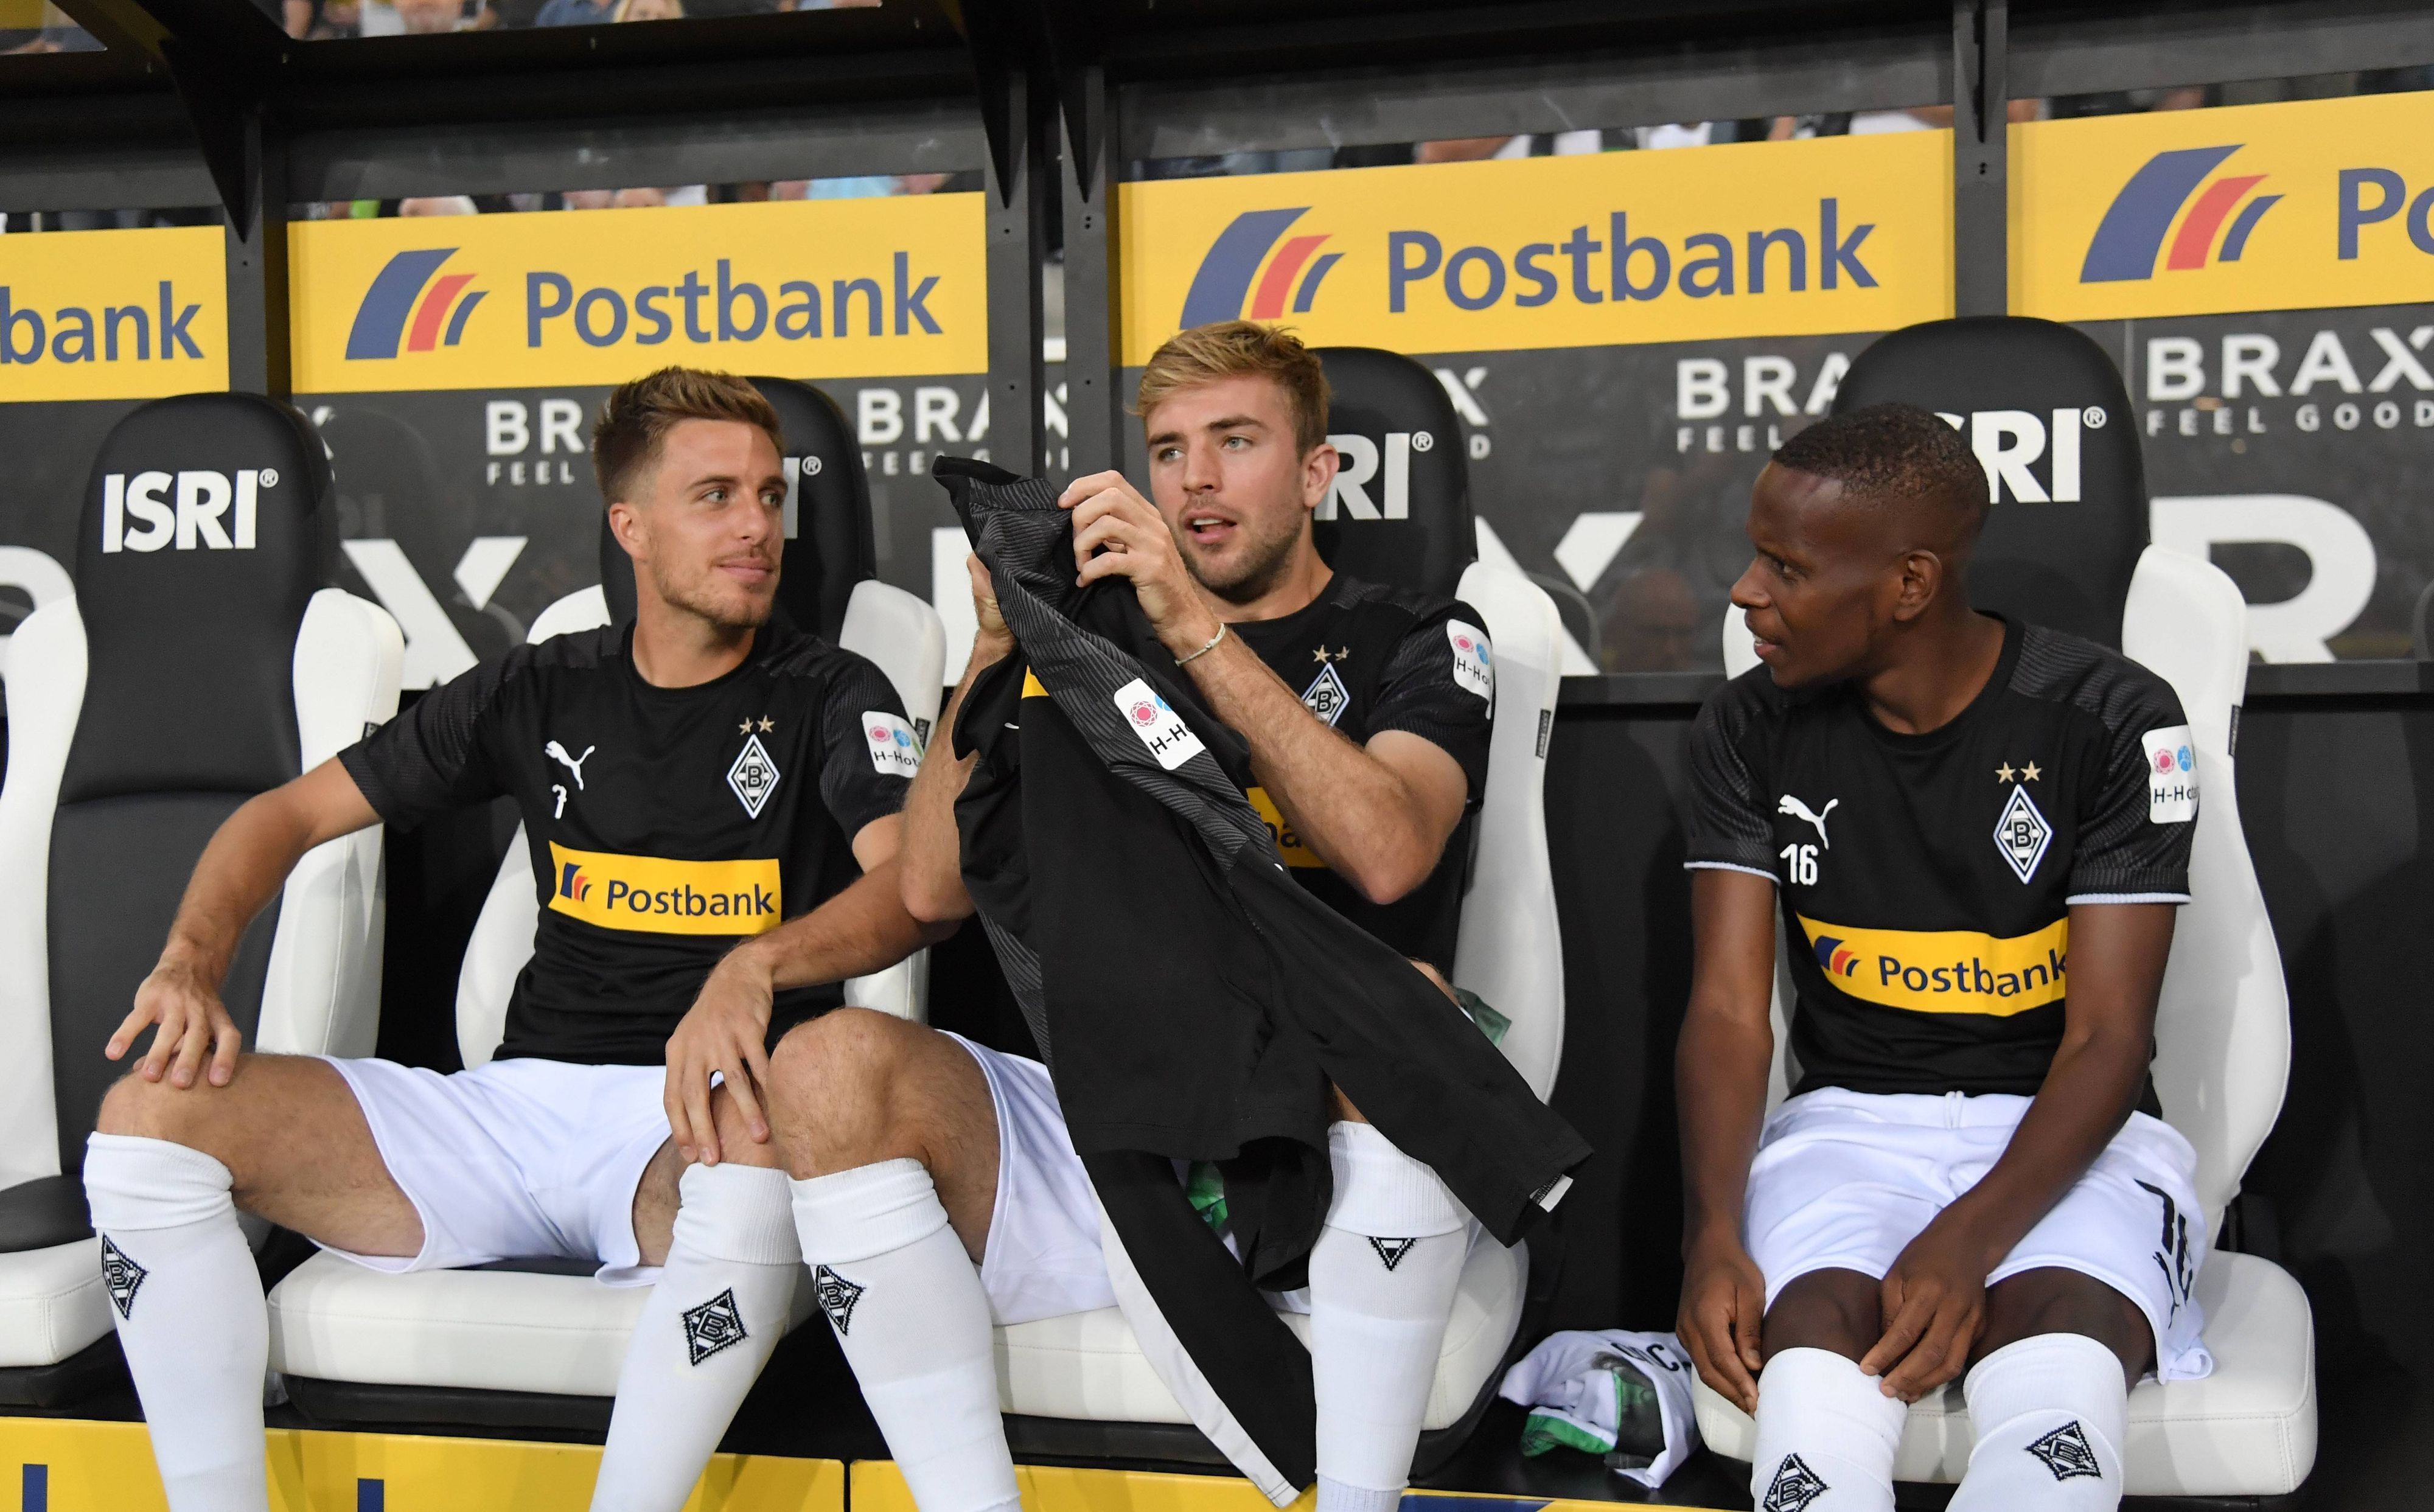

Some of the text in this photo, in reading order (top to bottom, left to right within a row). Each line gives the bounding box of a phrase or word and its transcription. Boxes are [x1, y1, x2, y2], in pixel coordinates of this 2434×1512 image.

[1388, 198, 1880, 313] Postbank
[526, 252, 943, 348] Postbank
[2146, 326, 2434, 401] BRAX
[2147, 400, 2434, 436] FEEL GOOD
[1677, 424, 1784, 453] FEEL
[487, 461, 575, 486] FEEL
[861, 449, 945, 476] FEE
[1149, 723, 1190, 755] H-H
[1779, 843, 1819, 886] 16
[607, 880, 775, 916] Postbank
[1878, 948, 2066, 997] Postbank
